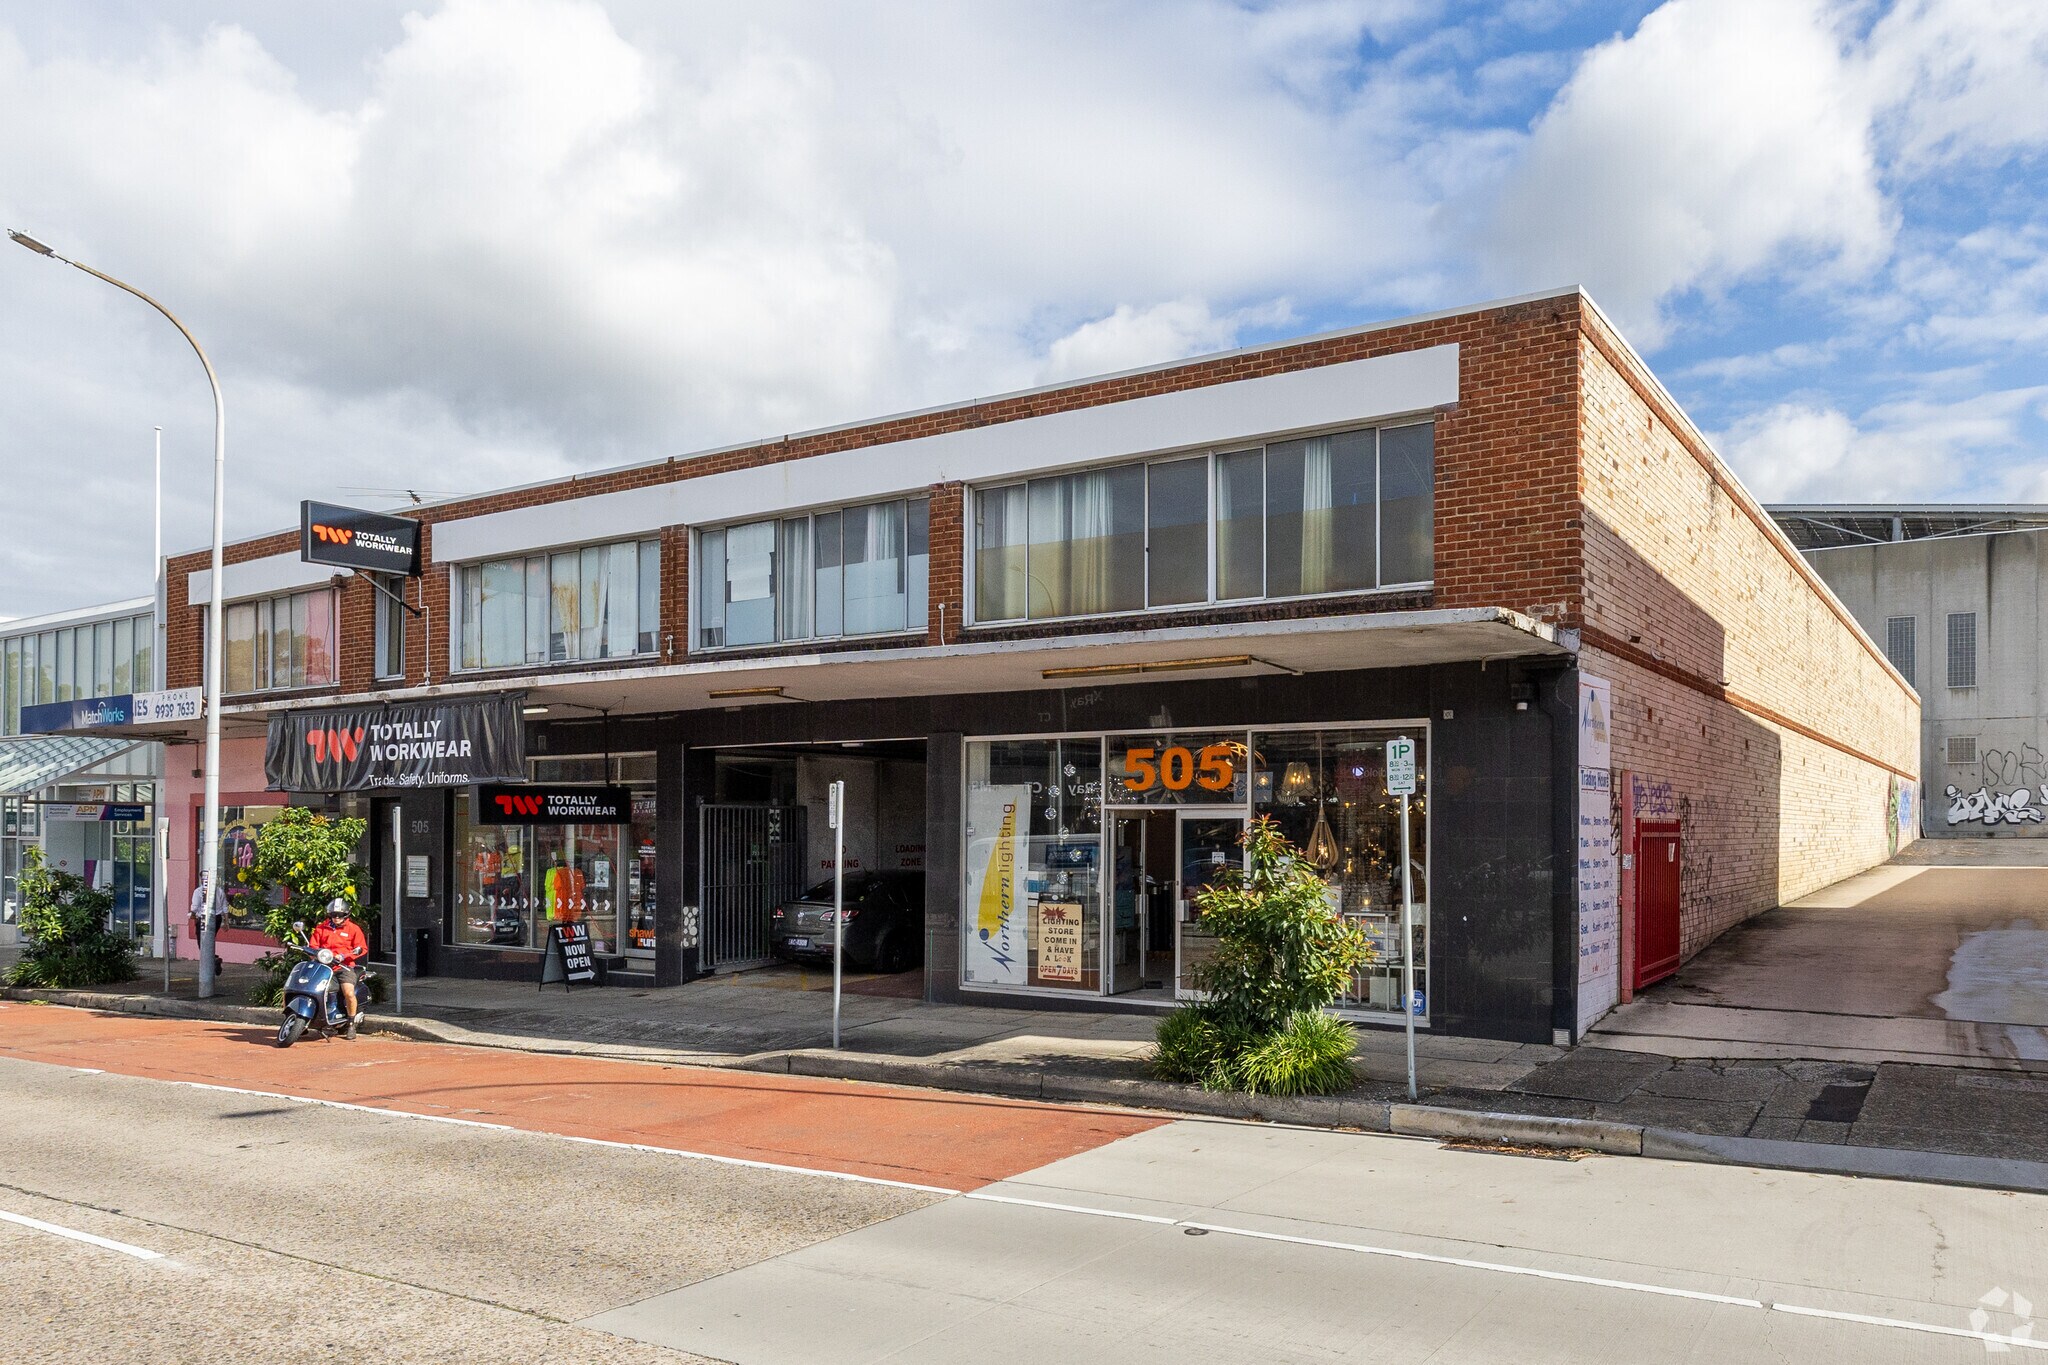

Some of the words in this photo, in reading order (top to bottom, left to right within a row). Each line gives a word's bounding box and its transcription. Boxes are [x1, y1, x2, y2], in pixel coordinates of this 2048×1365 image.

[355, 531, 397, 545] TOTALLY
[355, 539, 413, 555] WORKWEAR
[161, 692, 189, 701] PHONE
[133, 699, 149, 718] IES
[155, 704, 174, 719] 9939
[177, 702, 195, 717] 7633
[81, 708, 125, 725] MatchWorks
[370, 720, 442, 742] TOTALLY
[370, 739, 472, 762] WORKWEAR
[1392, 744, 1410, 759] 1P
[1123, 746, 1233, 791] 505
[399, 772, 425, 788] Safety.
[427, 770, 470, 784] Uniforms.
[1580, 769, 1596, 790] Trading
[547, 795, 597, 805] TOTALLY
[547, 806, 617, 816] WORKWEAR
[411, 820, 429, 834] 505
[998, 803, 1016, 873] lighting
[821, 859, 859, 869] PARING
[900, 857, 921, 867] ZONE
[982, 877, 1017, 974] Northern
[1042, 918, 1079, 926] LIGHTING
[555, 924, 585, 939] TWW
[1048, 927, 1074, 935] STORE
[1044, 936, 1067, 944] COME
[564, 944, 586, 957] NOW
[1054, 946, 1074, 954] HAVE
[567, 956, 591, 969] OPEN
[1040, 965, 1056, 973] OPEN
[1056, 965, 1063, 976] 7
[1062, 966, 1078, 975] DAYS
